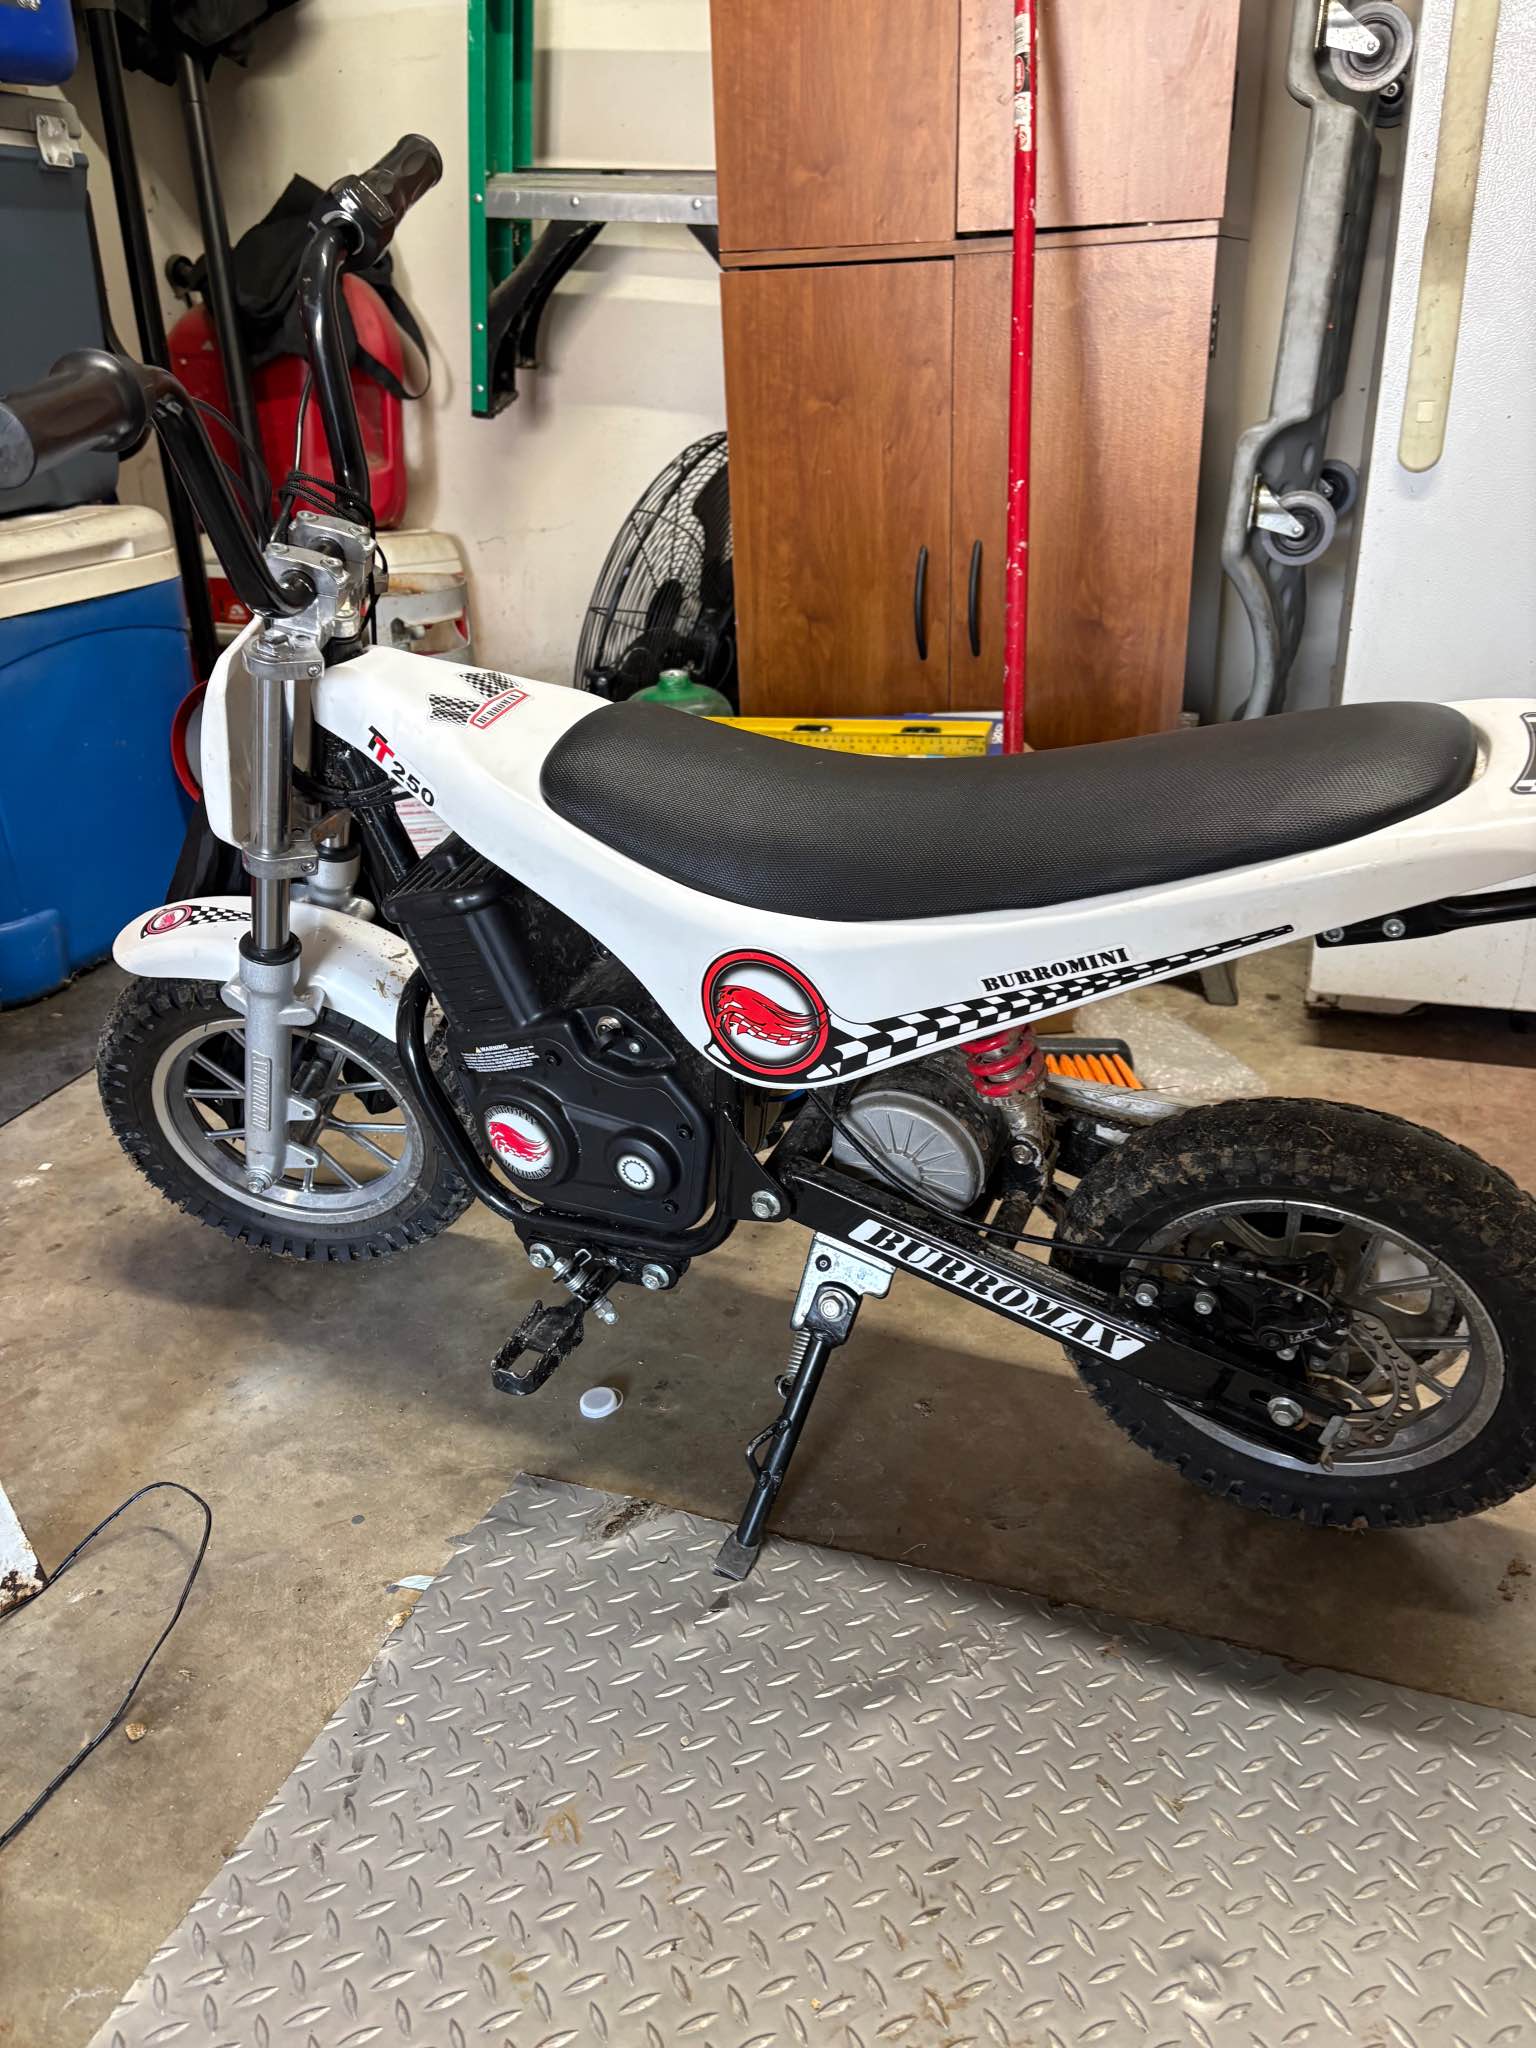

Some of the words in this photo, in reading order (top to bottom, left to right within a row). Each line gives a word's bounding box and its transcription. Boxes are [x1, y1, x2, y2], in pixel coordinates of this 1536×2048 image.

[390, 760, 435, 808] 250
[980, 947, 1131, 992] BURROMINI
[863, 1225, 1133, 1354] BURROMAX
